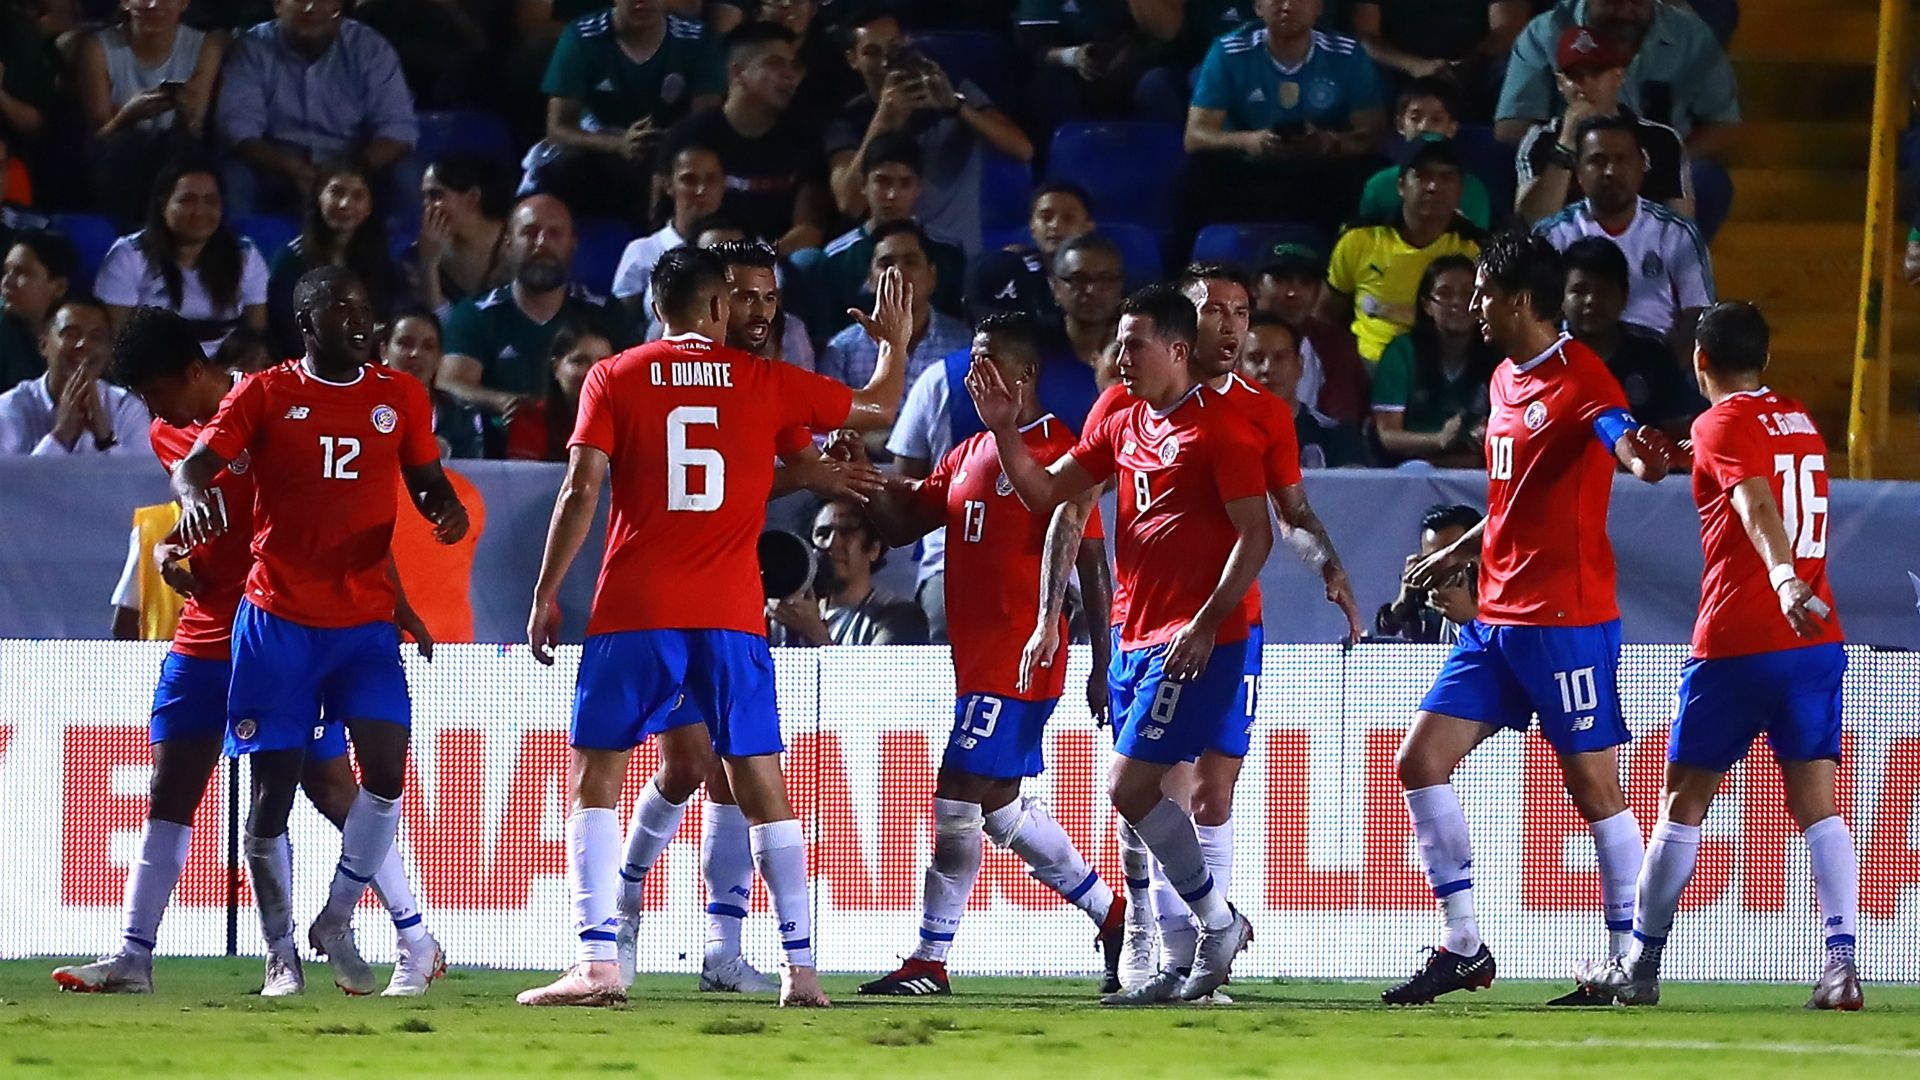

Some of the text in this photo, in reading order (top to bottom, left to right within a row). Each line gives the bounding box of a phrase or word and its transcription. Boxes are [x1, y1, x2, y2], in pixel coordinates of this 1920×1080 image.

[651, 362, 733, 387] O. DUARTE
[320, 436, 360, 479] 12
[667, 406, 725, 512] 6
[1489, 436, 1514, 480] 10
[1134, 470, 1151, 513] 8
[1774, 454, 1828, 559] 16
[964, 500, 985, 543] 13
[1151, 681, 1182, 724] 8
[1243, 675, 1262, 716] 1
[1554, 666, 1598, 713] 10
[963, 696, 1002, 737] 13
